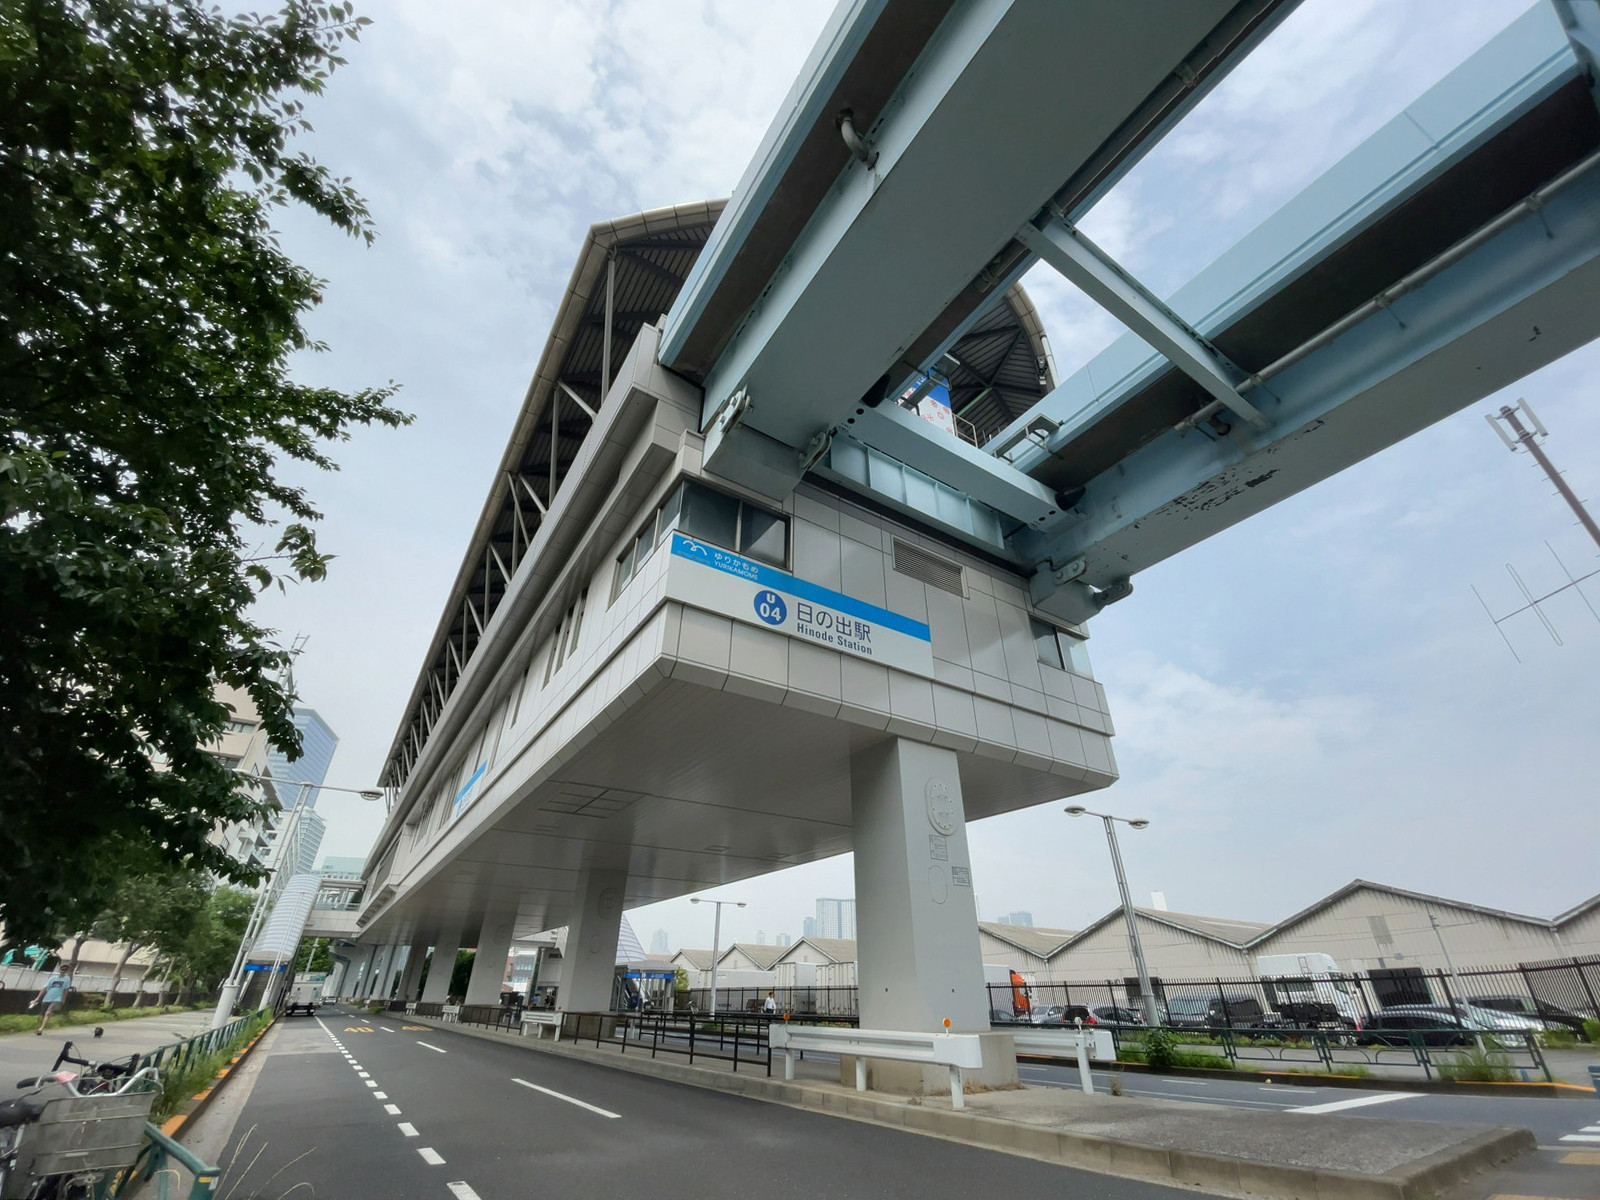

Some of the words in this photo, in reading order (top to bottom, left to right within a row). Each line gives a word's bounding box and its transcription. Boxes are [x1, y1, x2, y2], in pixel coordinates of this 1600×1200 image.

[714, 552, 759, 574] ゆりかもめ
[714, 560, 759, 580] YURIKAMOME
[766, 593, 775, 603] U
[759, 603, 782, 621] 04
[797, 602, 872, 643] 日の出駅
[797, 622, 834, 643] Hinode
[837, 635, 873, 655] Station
